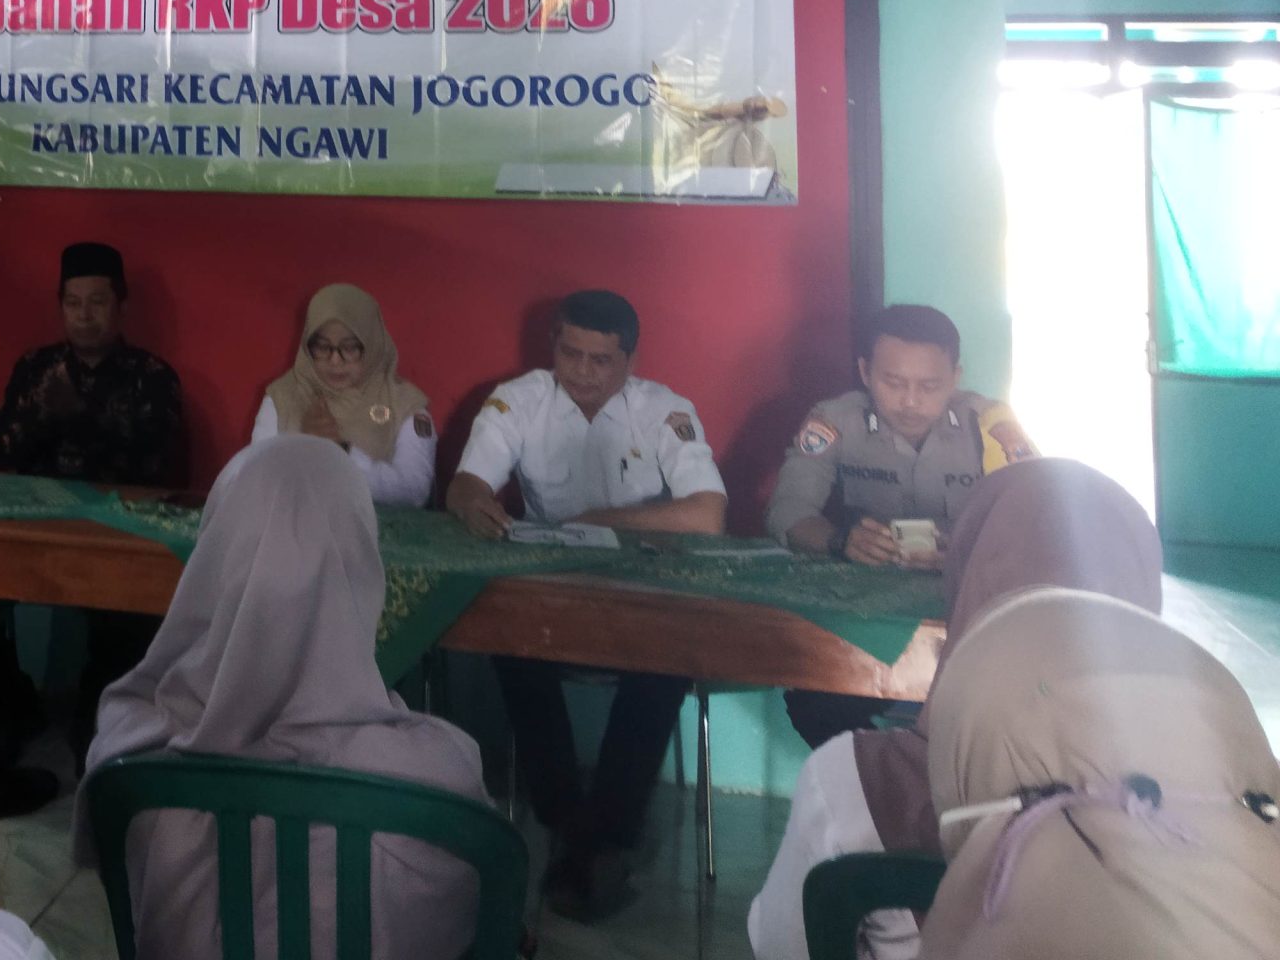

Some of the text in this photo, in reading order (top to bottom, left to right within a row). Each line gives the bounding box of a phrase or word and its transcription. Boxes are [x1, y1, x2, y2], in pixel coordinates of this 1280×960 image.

[165, 73, 395, 105] KECAMATAN
[412, 73, 654, 114] JOGOROGO
[34, 123, 388, 159] KABUPATEN NGAWI
